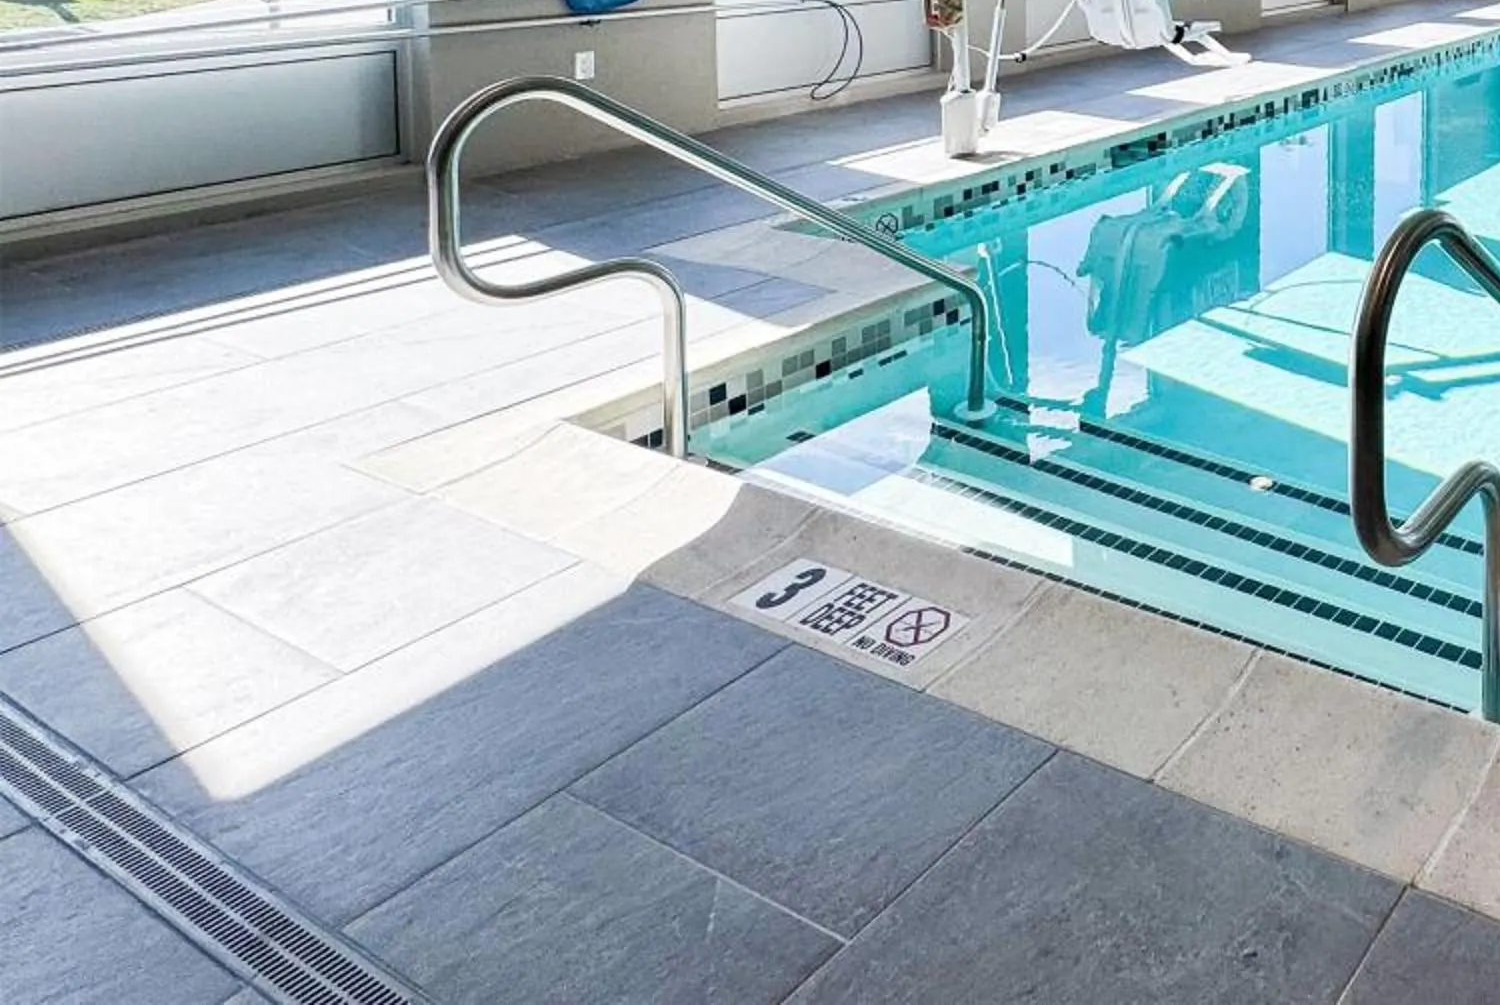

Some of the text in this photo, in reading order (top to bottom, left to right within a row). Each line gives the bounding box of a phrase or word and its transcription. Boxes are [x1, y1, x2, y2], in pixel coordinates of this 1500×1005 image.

[755, 567, 828, 610] 3
[833, 582, 899, 614] FEET
[799, 602, 867, 636] DEEP
[851, 635, 916, 667] NO DIVING
